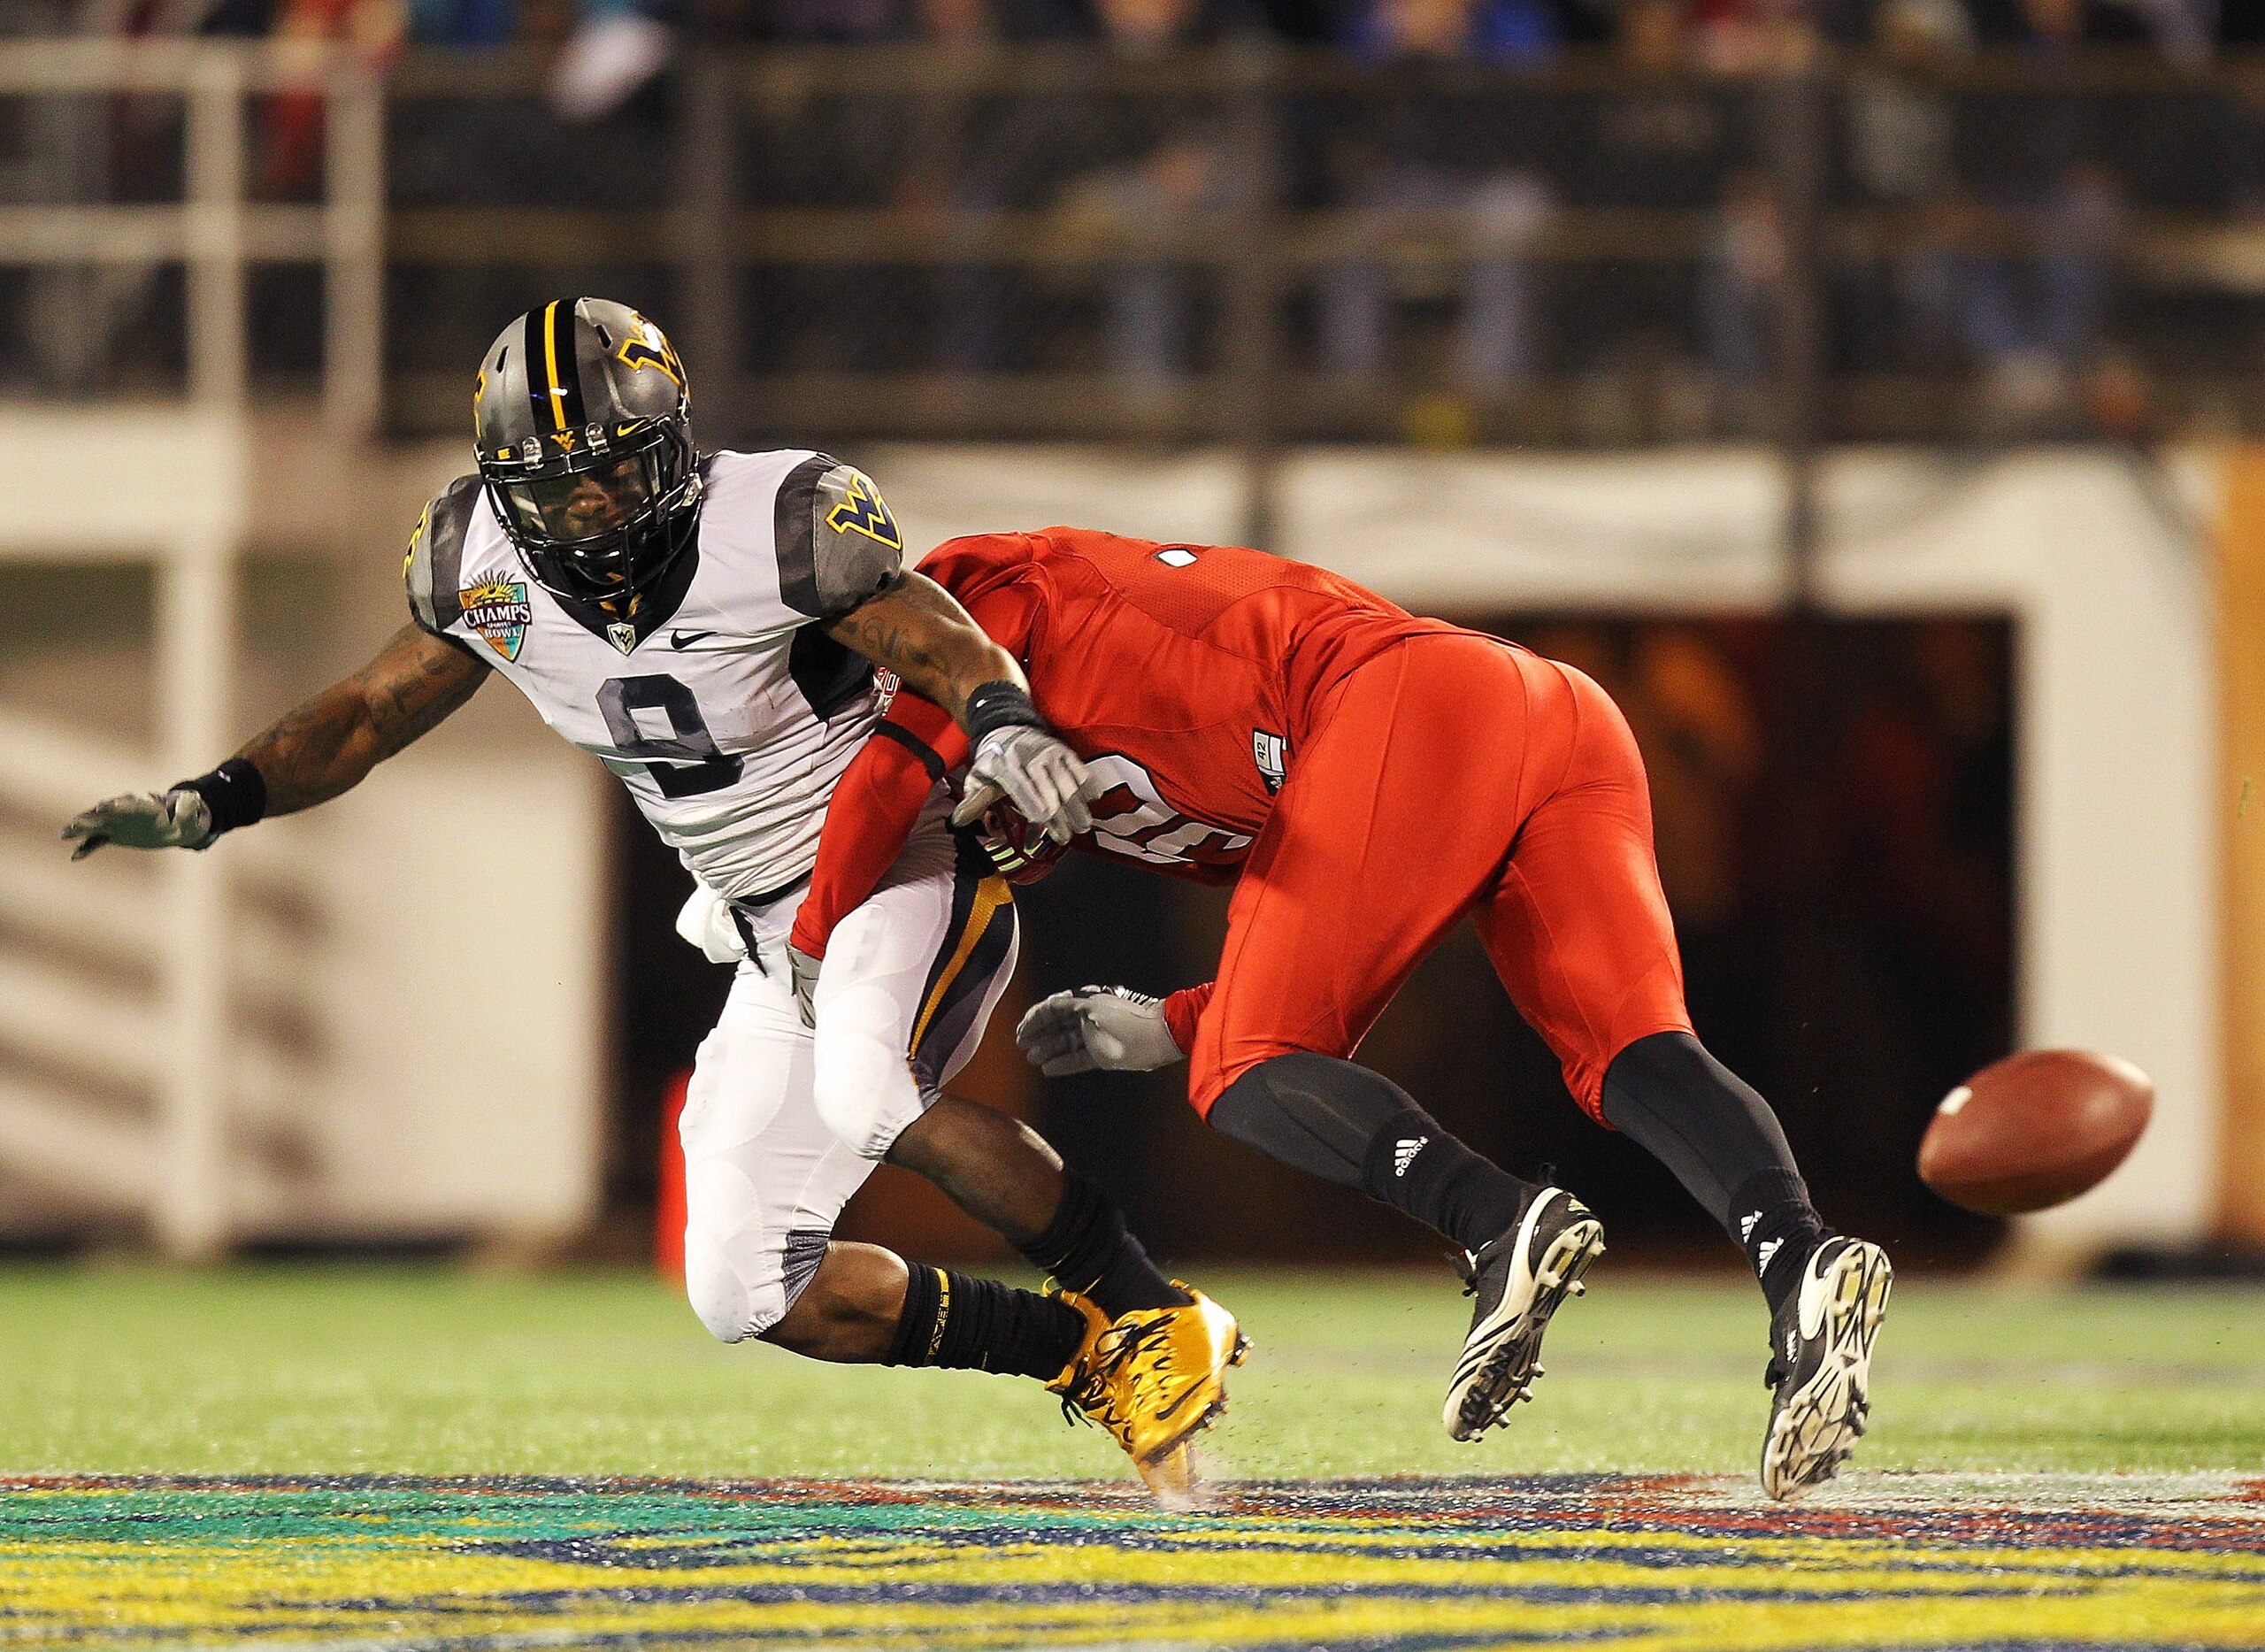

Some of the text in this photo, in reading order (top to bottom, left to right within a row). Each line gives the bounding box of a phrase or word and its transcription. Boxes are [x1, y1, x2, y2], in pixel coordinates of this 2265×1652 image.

[464, 603, 531, 626] CHAMPS
[484, 626, 520, 638] BOWL
[595, 673, 745, 799] 9
